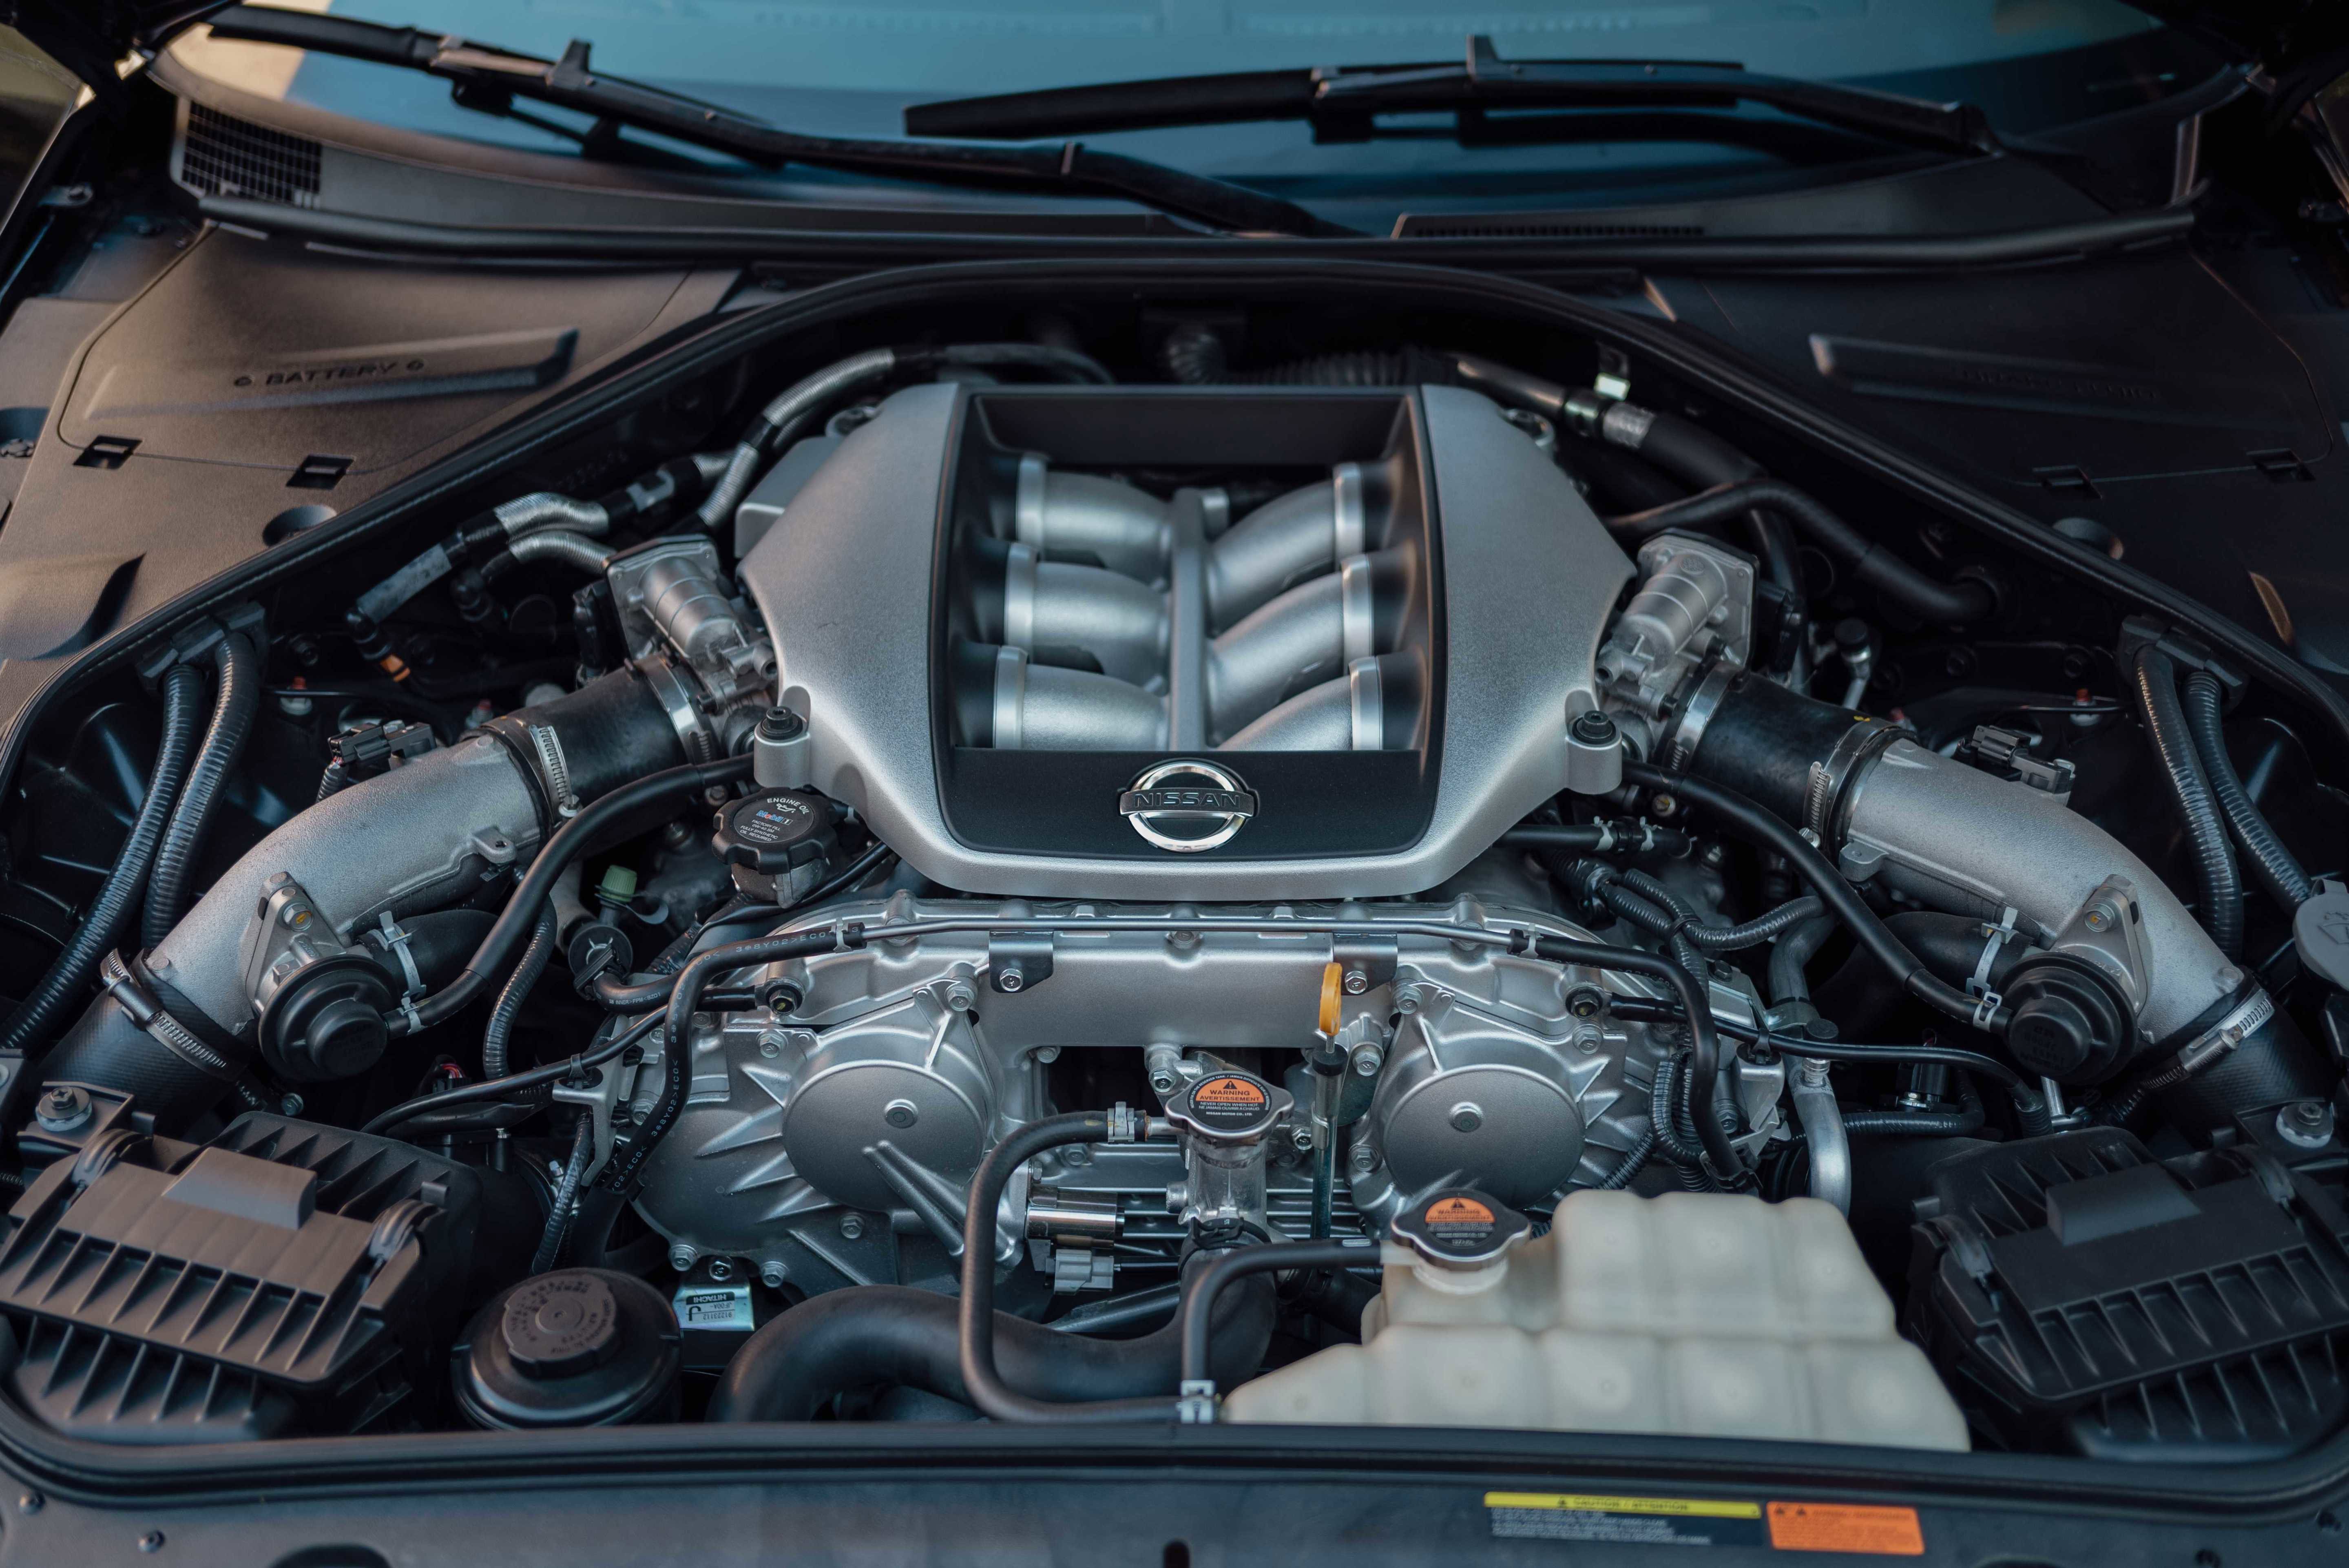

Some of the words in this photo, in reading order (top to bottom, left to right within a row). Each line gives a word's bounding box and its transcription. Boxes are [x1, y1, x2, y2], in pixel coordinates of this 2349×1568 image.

[266, 362, 397, 385] BATTERY
[767, 798, 801, 807] ENGINE
[799, 805, 810, 815] OIL
[1134, 792, 1240, 809] NISSAN
[756, 810, 784, 823] Mobil
[752, 819, 772, 828] FACTORY
[748, 832, 772, 842] REQUIRED
[753, 829, 778, 839] SYNTHETIC
[693, 1294, 727, 1303] HITACHI
[688, 1305, 701, 1321] J
